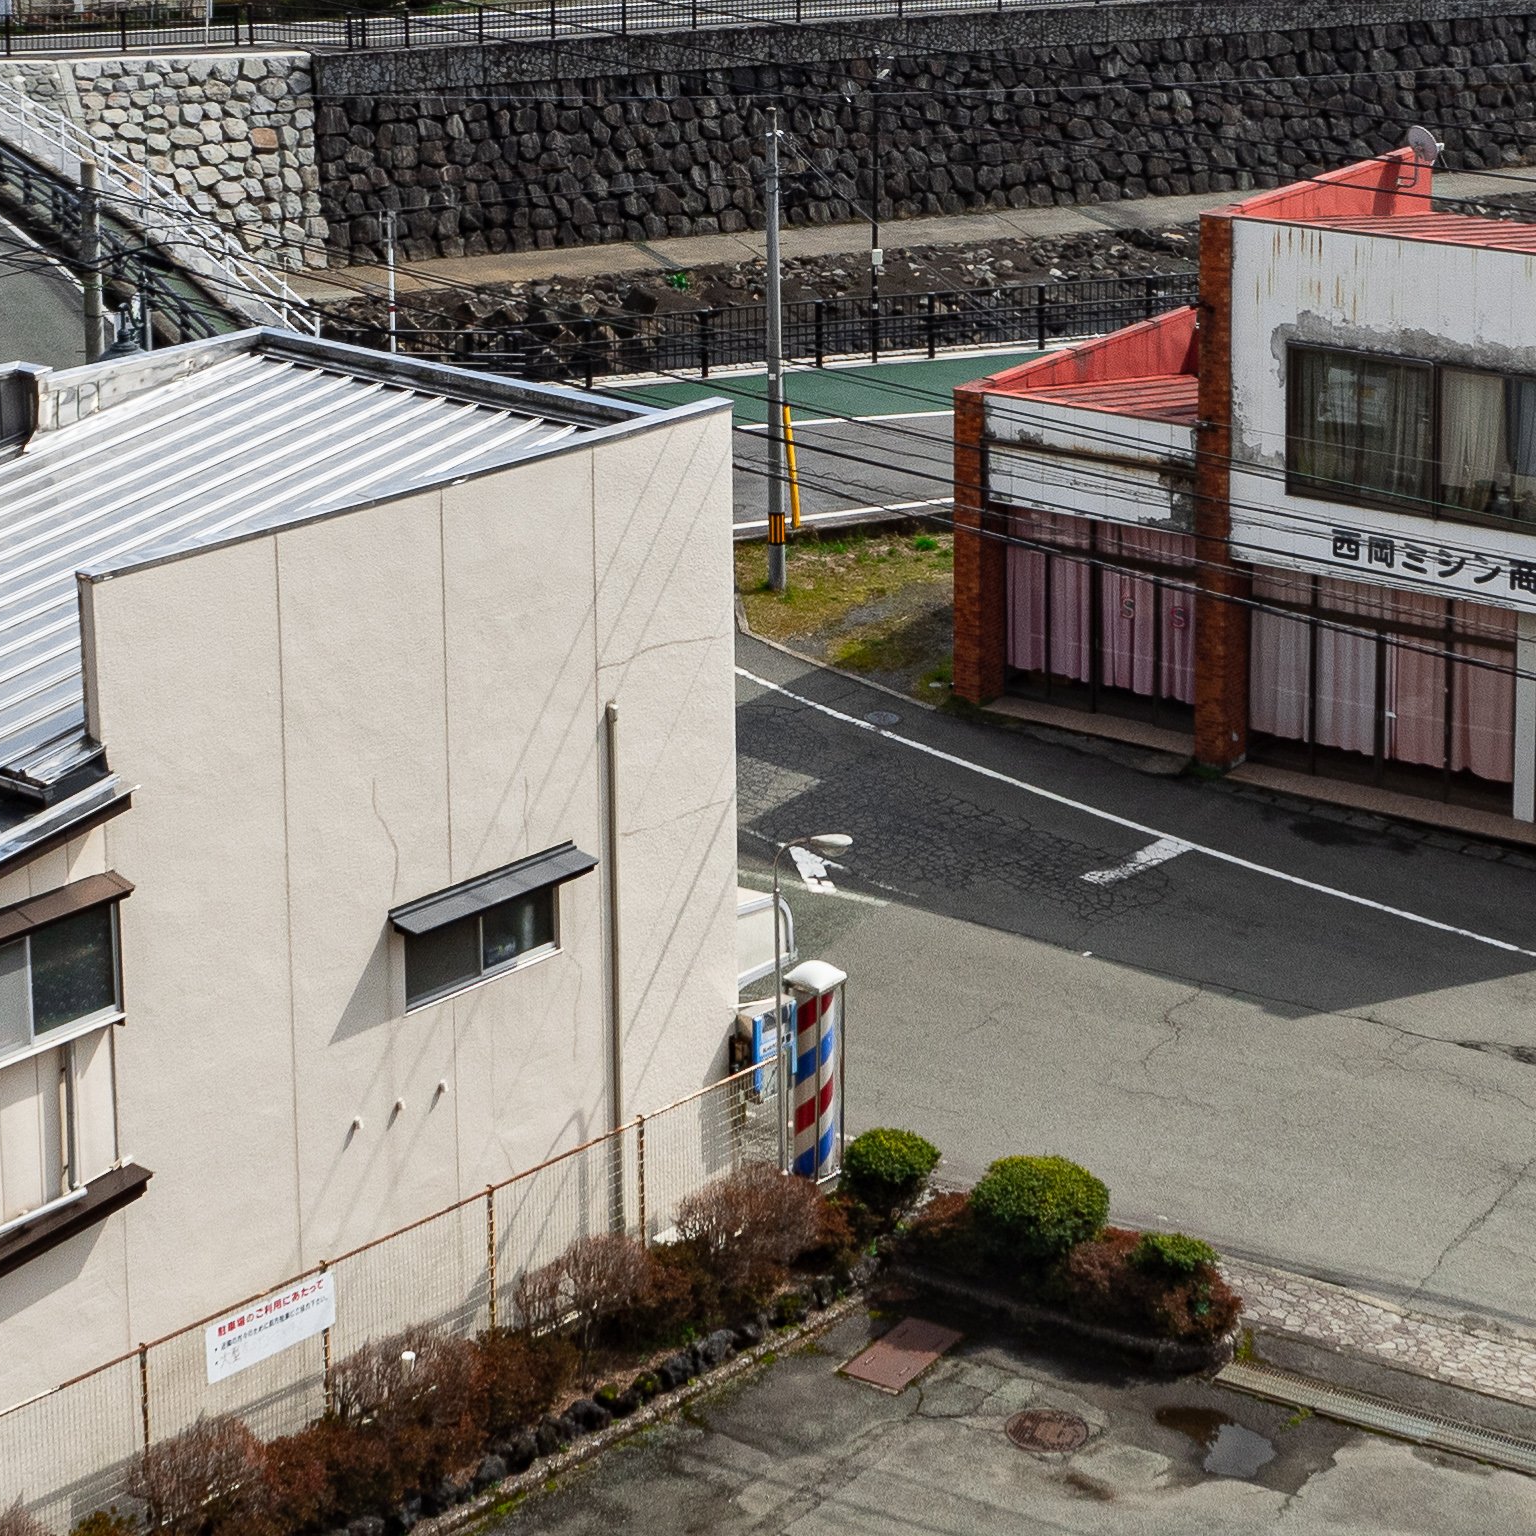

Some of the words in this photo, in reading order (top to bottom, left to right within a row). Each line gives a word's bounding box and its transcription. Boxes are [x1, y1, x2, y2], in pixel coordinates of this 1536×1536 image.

[217, 1279, 325, 1337] 駐車場のご利用にあたって
